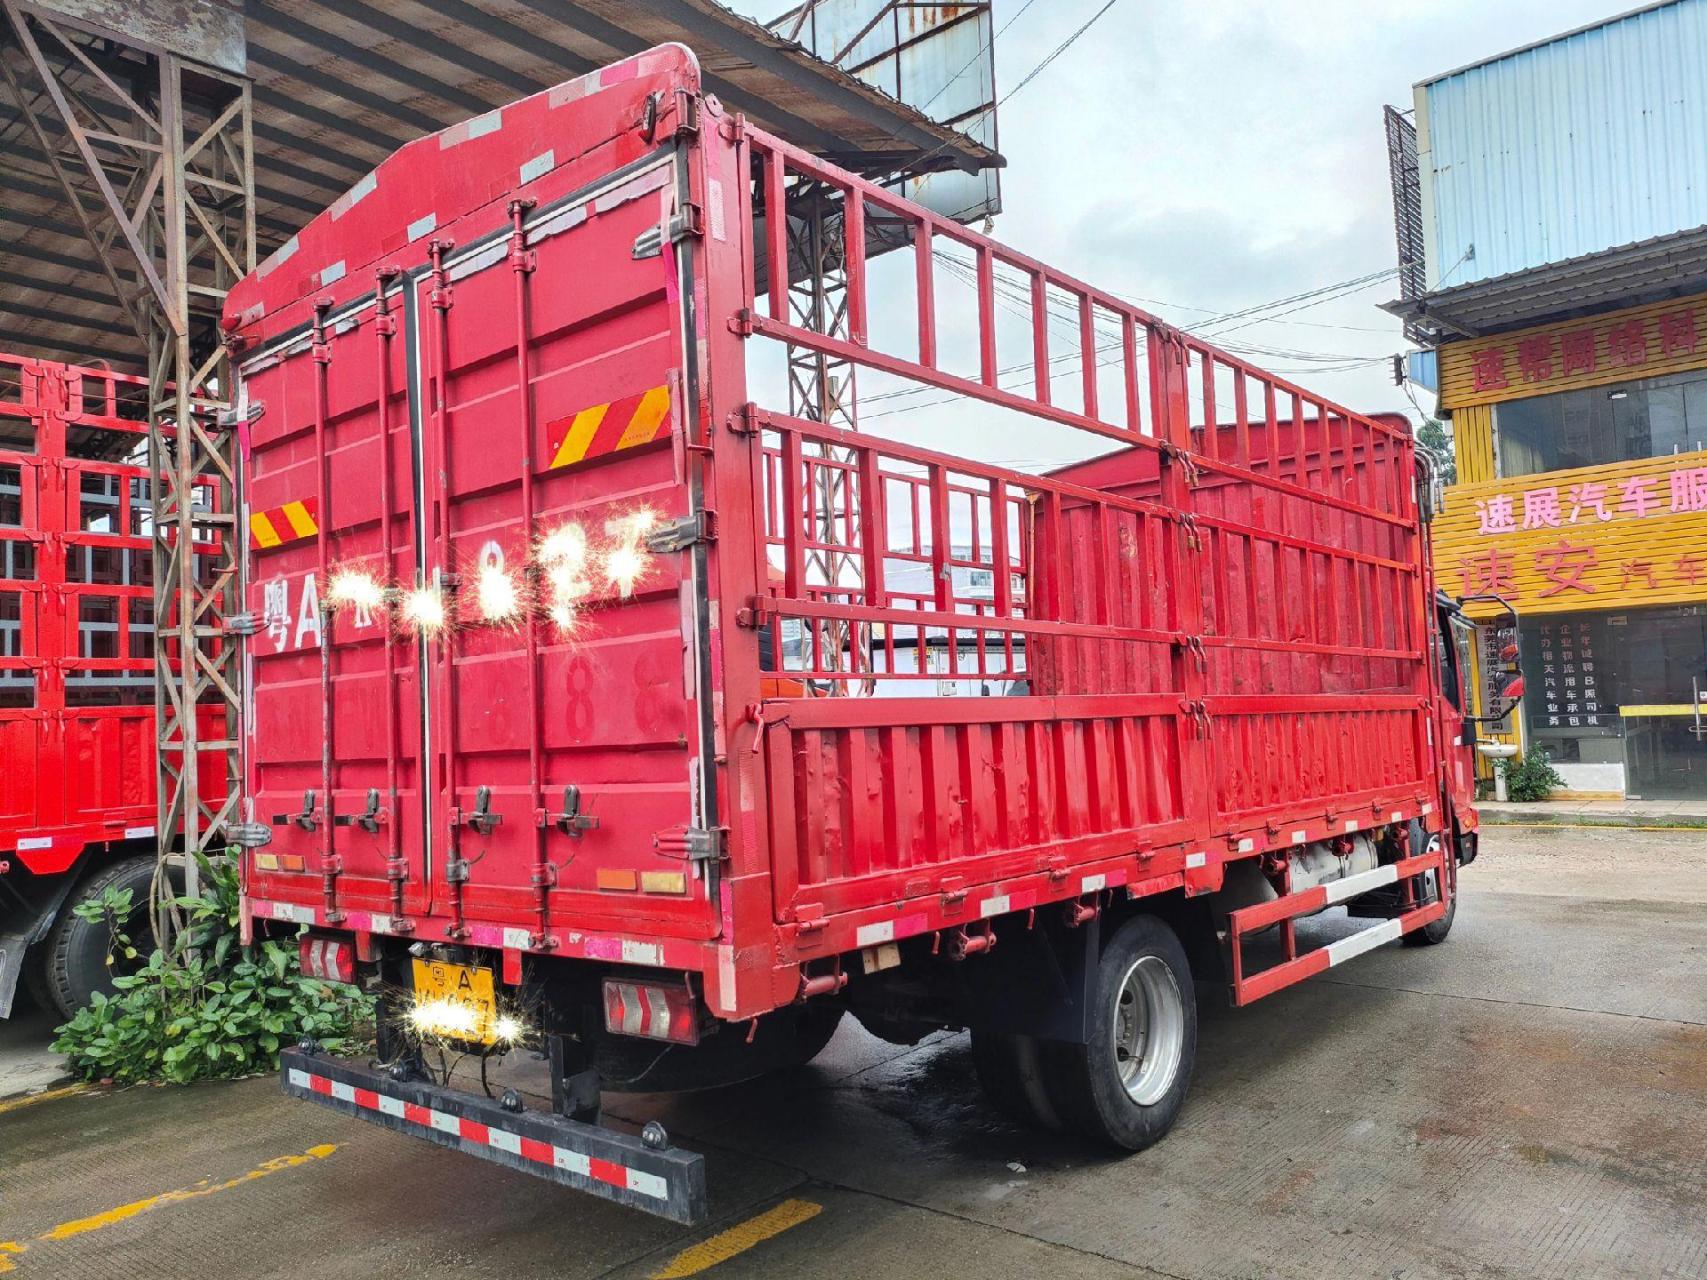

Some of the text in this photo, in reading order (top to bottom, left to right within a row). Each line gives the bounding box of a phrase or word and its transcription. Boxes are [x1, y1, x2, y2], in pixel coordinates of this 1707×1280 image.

[1475, 467, 1707, 534] 速展汽车服
